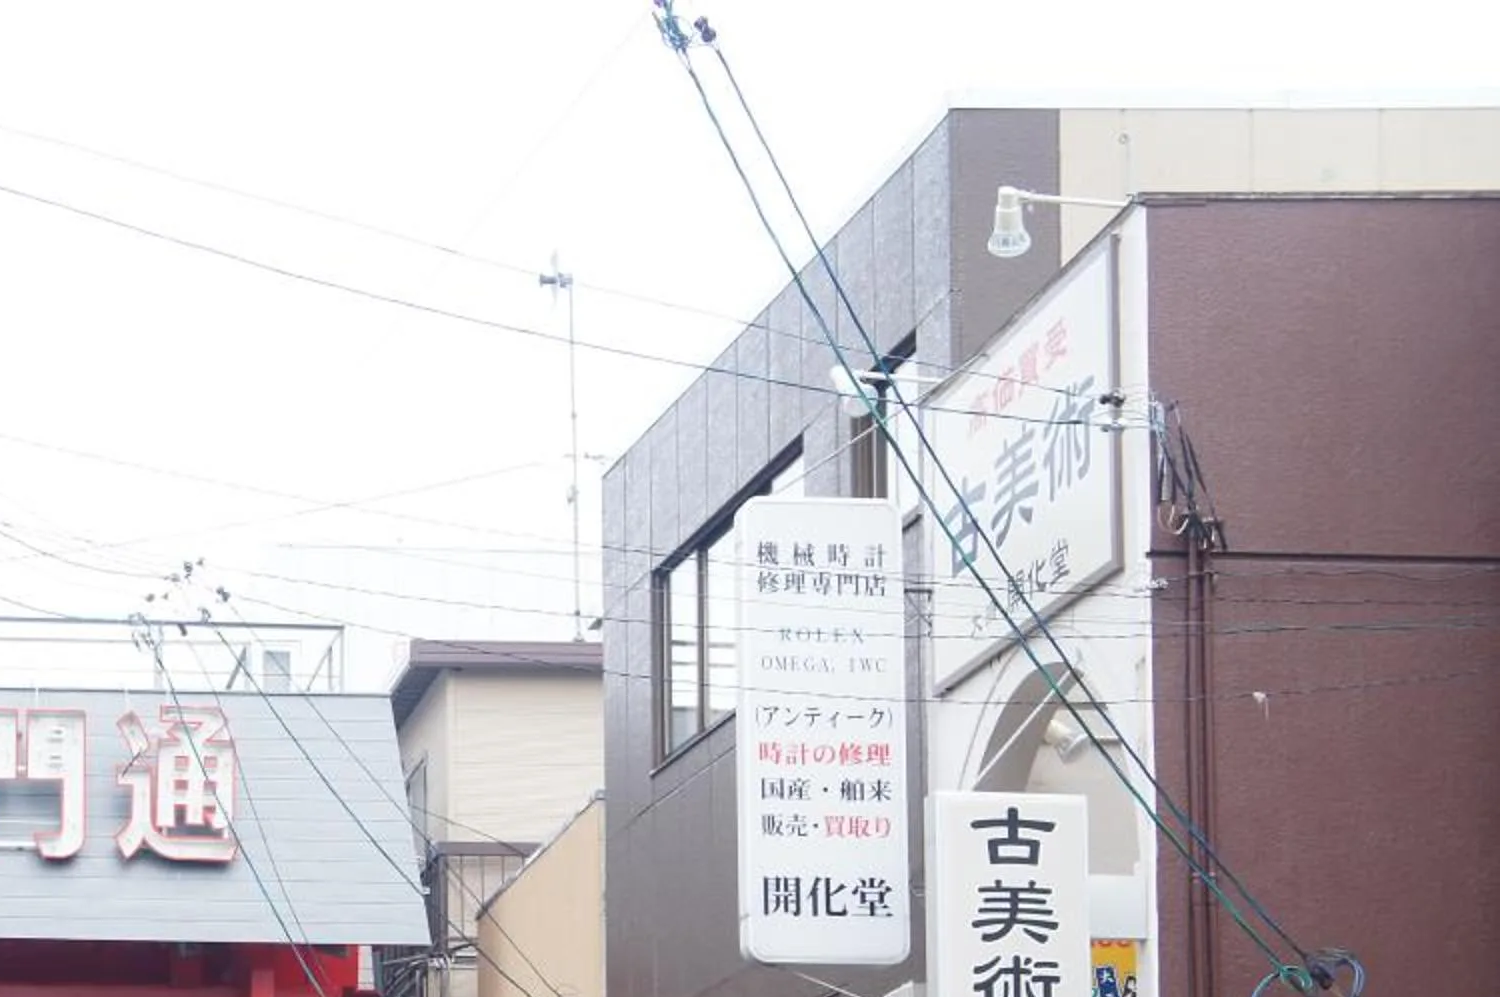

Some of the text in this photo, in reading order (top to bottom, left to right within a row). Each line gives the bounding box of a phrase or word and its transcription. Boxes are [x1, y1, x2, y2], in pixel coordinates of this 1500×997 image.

[942, 374, 1096, 580] 古美術
[756, 541, 888, 568] 機械時計
[756, 570, 888, 597] 修理専門店
[758, 742, 893, 767] 時計の修理
[760, 778, 893, 802] 国産・舶来
[761, 814, 892, 839] 販売・買取り
[761, 875, 894, 919] 開化堂
